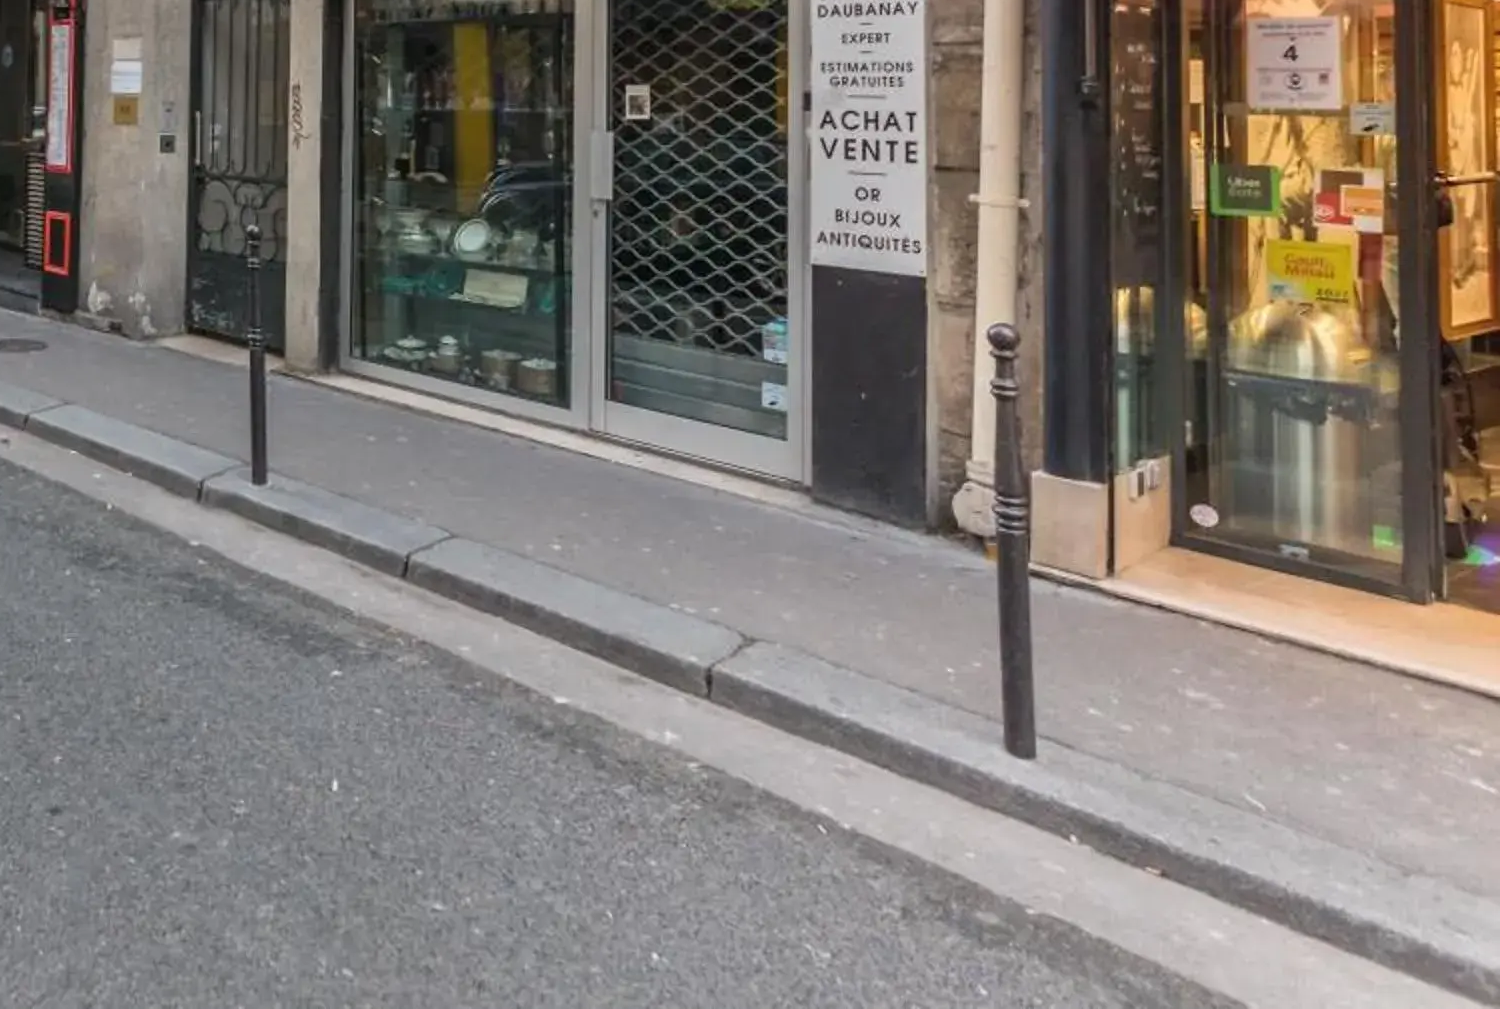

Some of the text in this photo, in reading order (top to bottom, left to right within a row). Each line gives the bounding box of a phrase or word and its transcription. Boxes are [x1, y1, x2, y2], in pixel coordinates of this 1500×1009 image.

[817, 2, 918, 18] DAUBANAY
[841, 32, 892, 44] EXPERT
[820, 62, 914, 73] ESTIMATIONS
[829, 76, 905, 88] GRATUITES
[819, 110, 918, 133] ACHAT
[820, 138, 918, 164] VENTE
[854, 187, 881, 202] OR
[835, 209, 901, 227] BIJOUX
